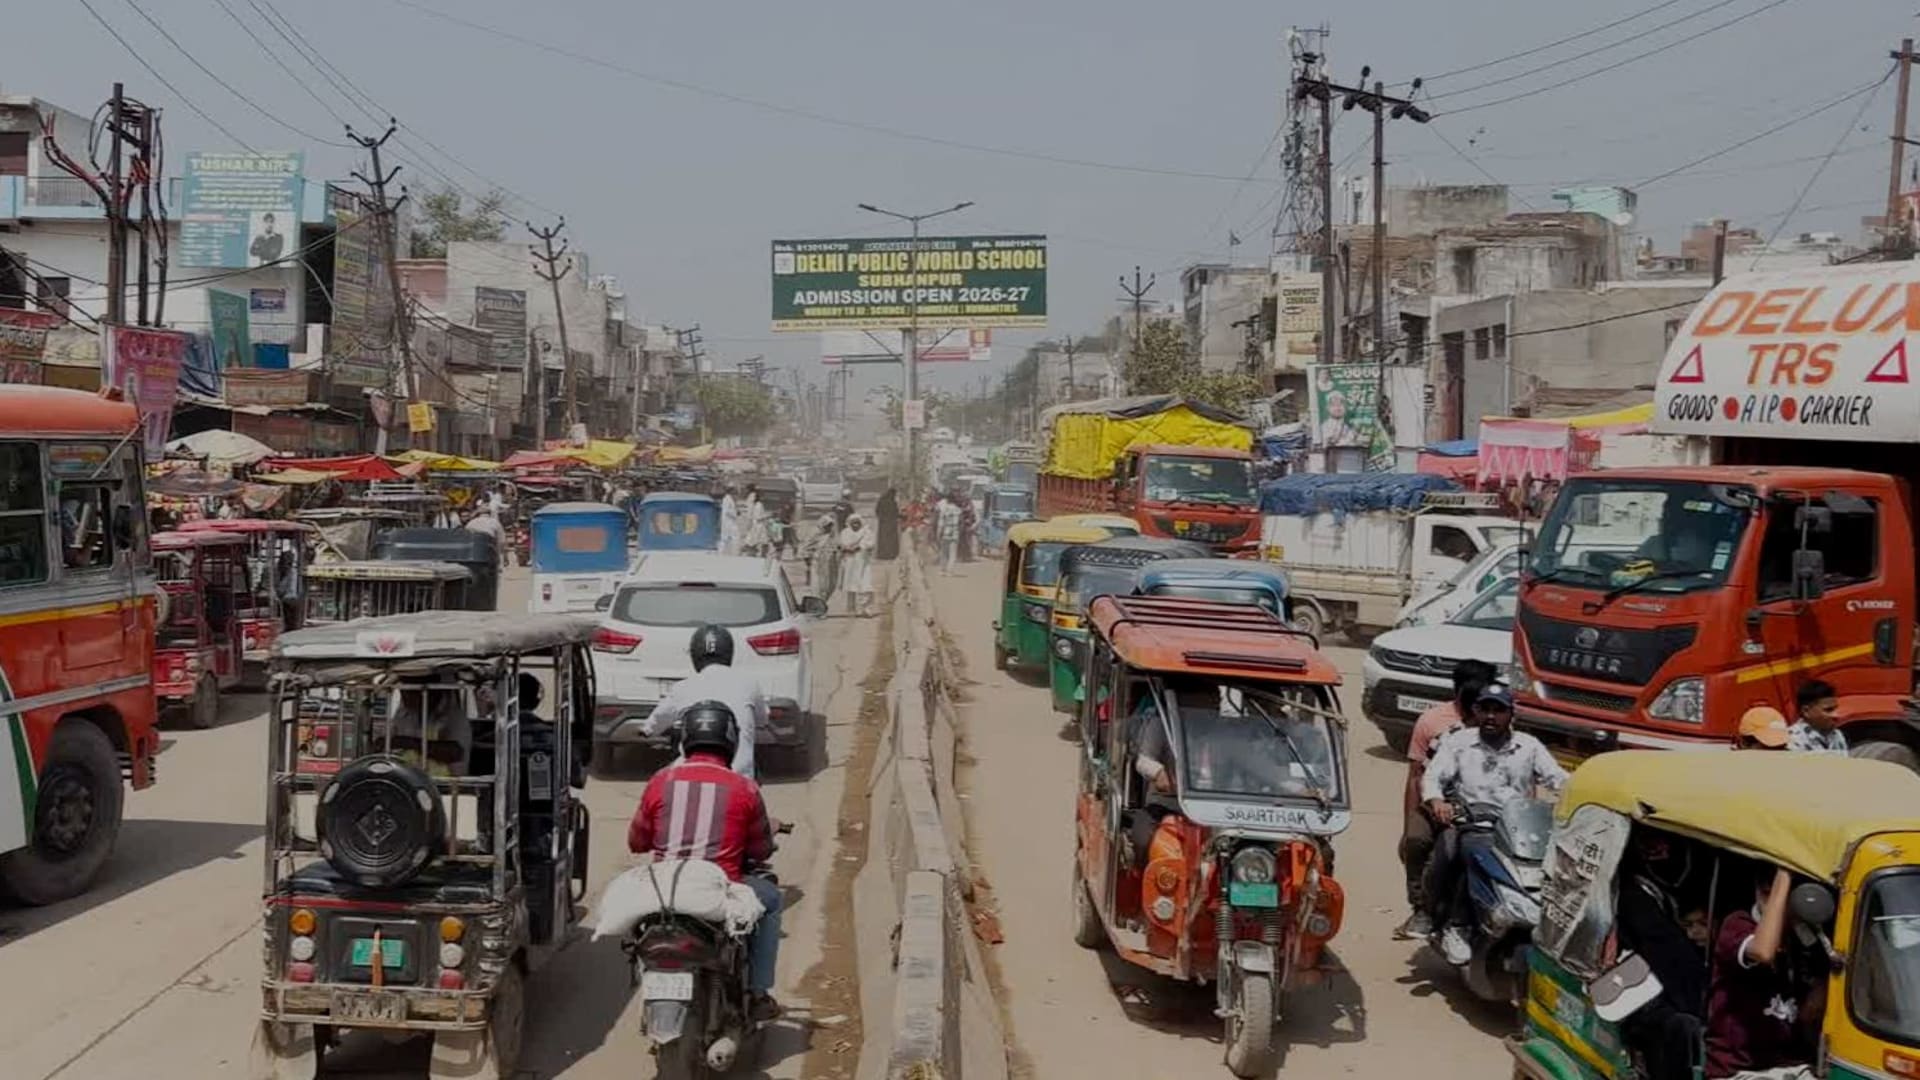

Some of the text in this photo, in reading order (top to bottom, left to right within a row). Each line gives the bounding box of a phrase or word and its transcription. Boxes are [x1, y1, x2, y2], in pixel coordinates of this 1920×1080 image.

[190, 158, 253, 171] TUSHAR
[796, 249, 1045, 273] DELHI PUBLIC WORLD SCHOOL
[859, 272, 963, 288] SUBHANPUR
[793, 286, 1030, 305] ADMISSION OPEN 2026-27
[1747, 342, 1841, 385] TRS
[1668, 394, 1718, 422] GOODS
[1800, 396, 1873, 426] CARRIER
[1225, 805, 1308, 824] SAARTHAK
